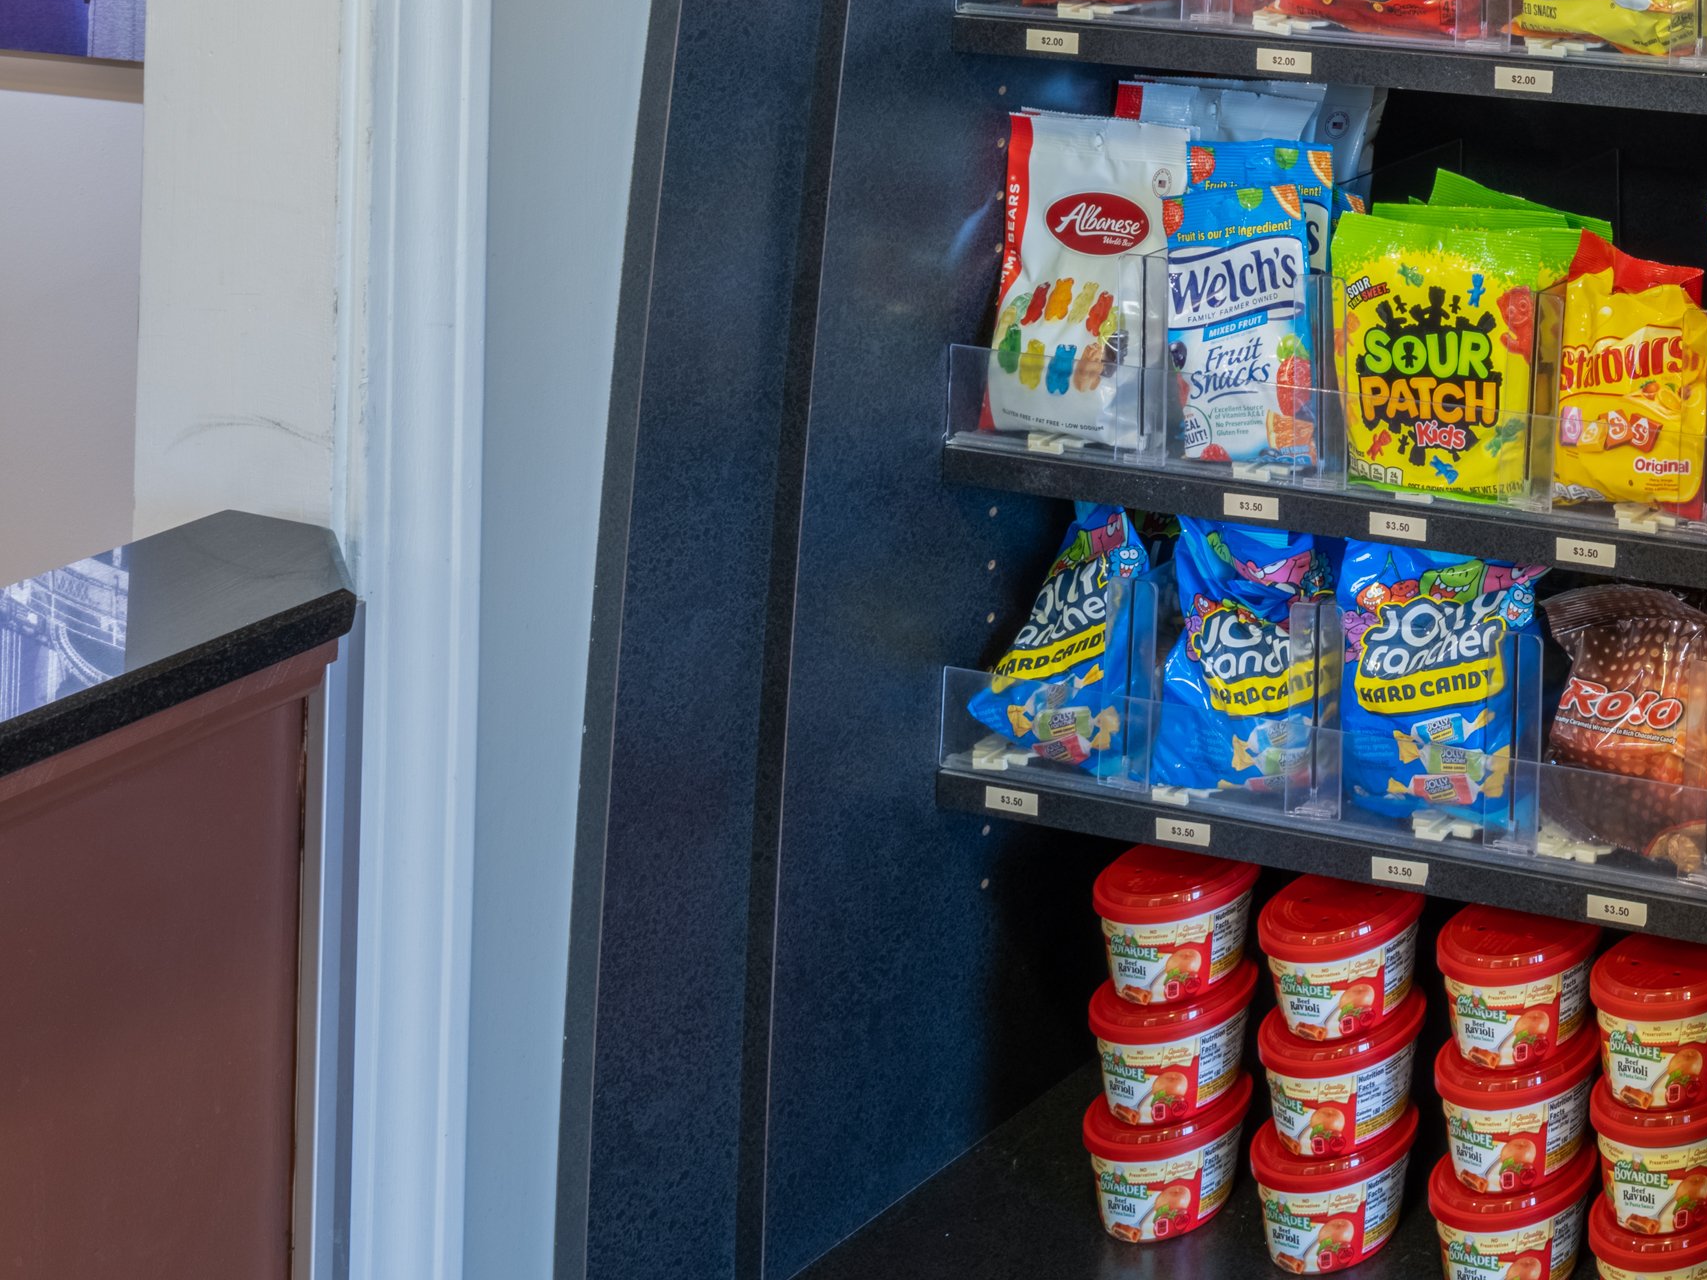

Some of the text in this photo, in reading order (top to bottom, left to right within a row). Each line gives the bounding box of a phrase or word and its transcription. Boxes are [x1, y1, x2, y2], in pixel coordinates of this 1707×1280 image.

[1061, 203, 1142, 235] Albanese
[1178, 232, 1196, 242] Fruit
[1199, 233, 1205, 241] is
[1208, 231, 1222, 240] our
[1170, 247, 1297, 316] Welch's
[1209, 316, 1262, 335] MIXED FRUIT
[1206, 342, 1263, 371] Fruit
[1365, 330, 1490, 378] SOUR
[1190, 365, 1271, 399] Snacks
[1361, 378, 1497, 423] PATCH
[1417, 422, 1466, 447] Kids
[1635, 458, 1689, 474] Original
[1240, 502, 1263, 512] $3.50
[1360, 669, 1495, 705] HARD CANDY
[1560, 679, 1682, 728] Rolo
[1388, 866, 1412, 877] $3.50
